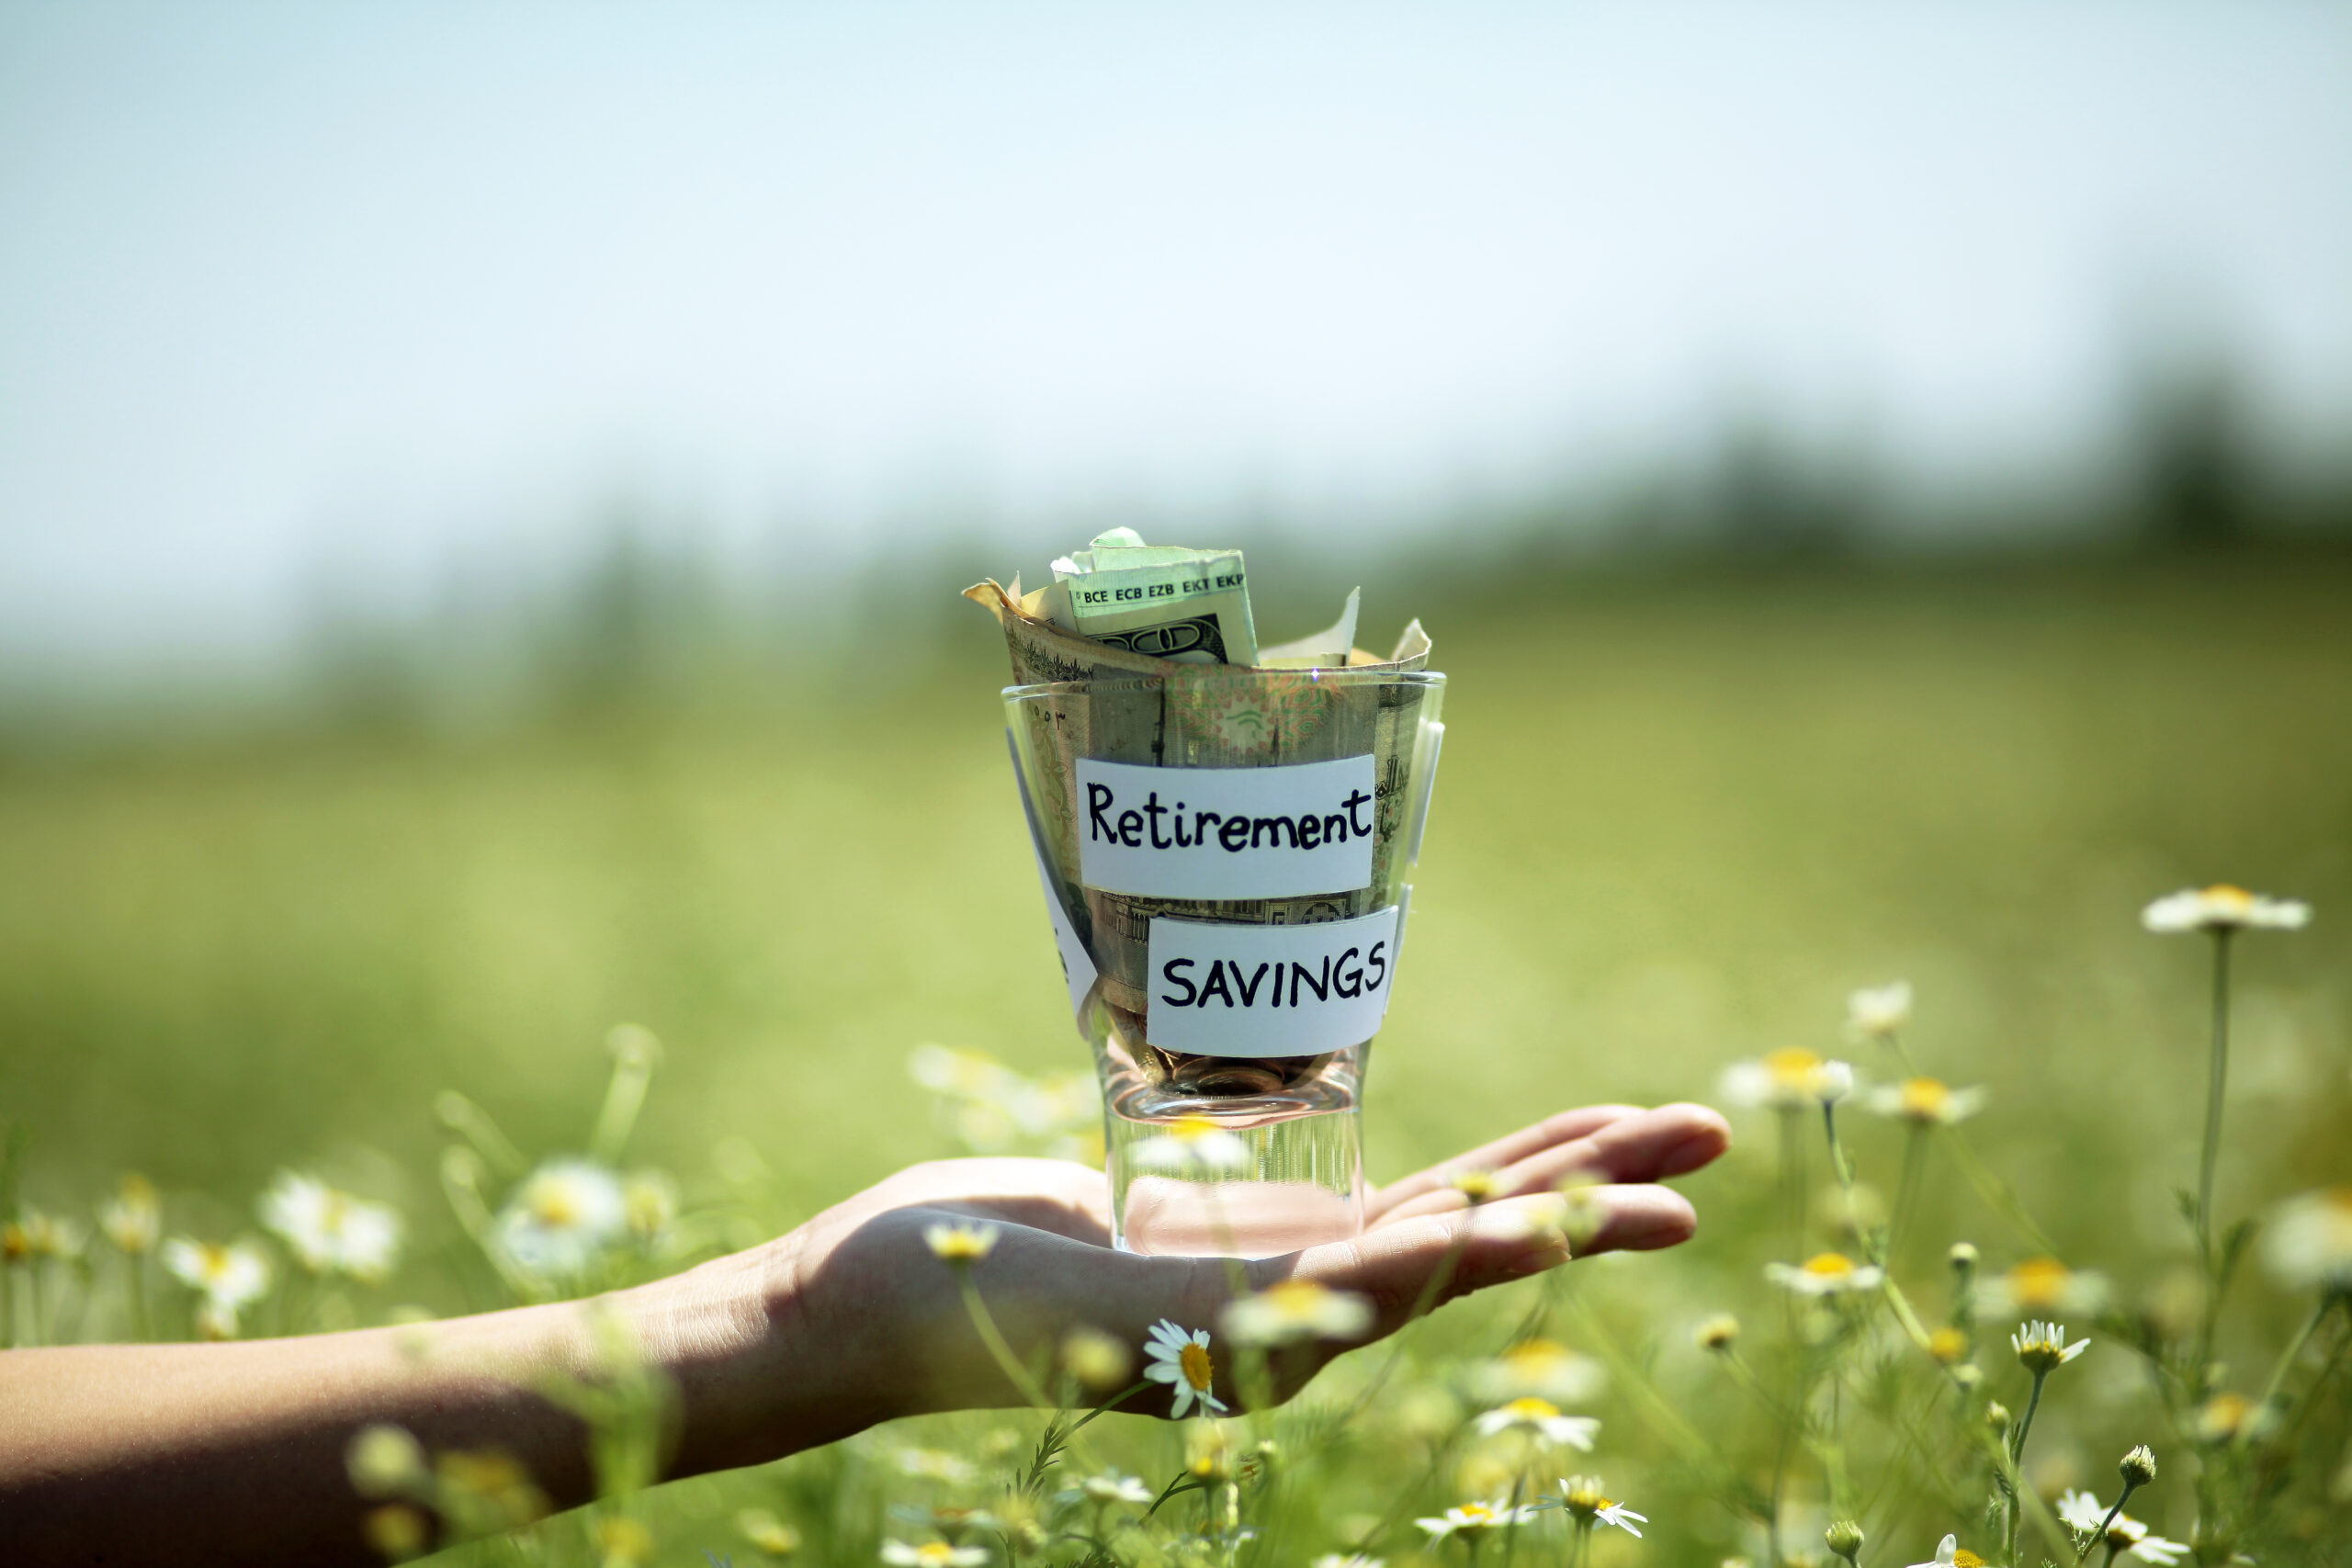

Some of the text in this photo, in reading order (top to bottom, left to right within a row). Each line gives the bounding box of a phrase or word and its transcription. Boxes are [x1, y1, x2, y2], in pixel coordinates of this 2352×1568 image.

[1084, 573, 1244, 603] BCE ECB EZB EKT EKP
[1087, 782, 1372, 852] Retirement
[1161, 941, 1385, 1008] SAVINGS
